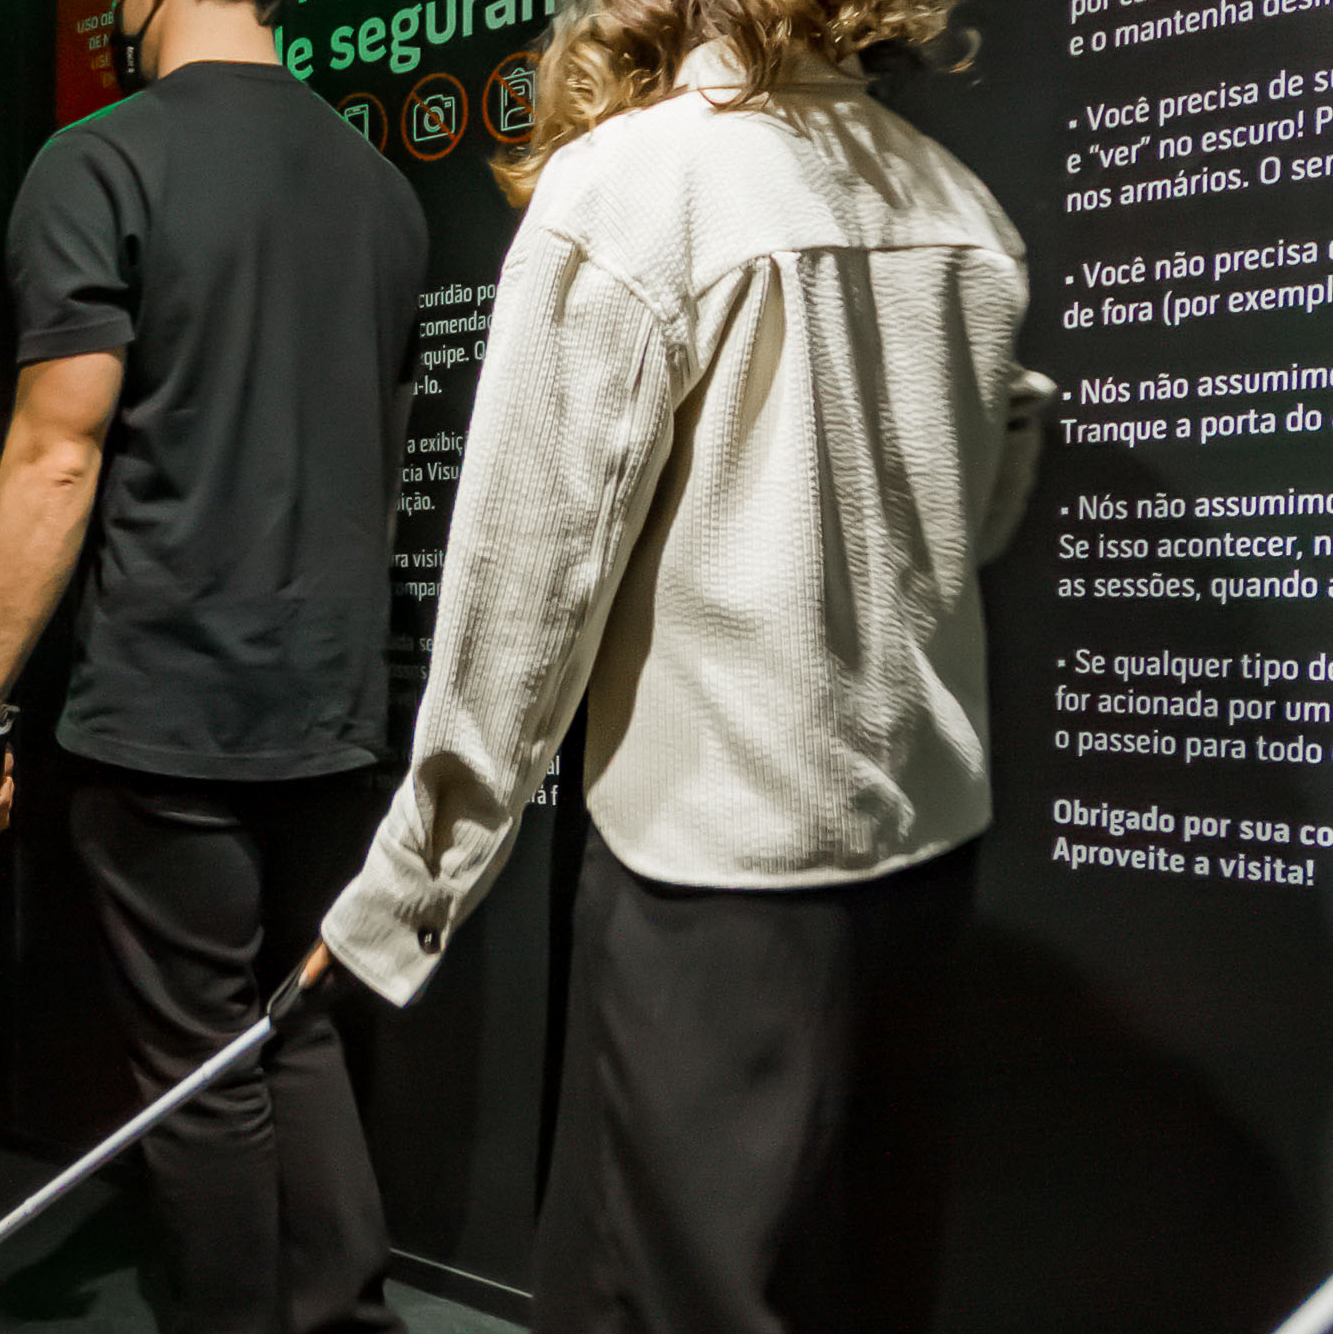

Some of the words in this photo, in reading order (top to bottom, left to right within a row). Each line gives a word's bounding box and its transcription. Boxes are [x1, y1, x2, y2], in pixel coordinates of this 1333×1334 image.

[1069, 36, 1084, 56] e
[1091, 31, 1106, 51] o
[1086, 97, 1150, 131] Você
[1158, 82, 1259, 127] precisa
[1268, 70, 1304, 99] de
[1314, 69, 1333, 92] s
[1067, 153, 1081, 174] e
[1158, 135, 1192, 159] no
[1201, 110, 1304, 152] escuro!
[1066, 187, 1112, 213] nos
[1120, 167, 1249, 205] armários.
[1259, 156, 1281, 184] O
[1082, 256, 1146, 289] Você
[1155, 251, 1205, 281] não
[1214, 239, 1318, 282] precisa
[1063, 301, 1094, 329] de
[1101, 297, 1153, 326] fora
[1163, 290, 1220, 326] (por
[1228, 274, 1333, 314] exempl
[421, 344, 469, 370] quipe.
[1081, 376, 1130, 405] Nós
[1139, 373, 1188, 401] não
[1197, 363, 1333, 397] assumim
[1060, 418, 1167, 448] Tranque
[1175, 417, 1191, 438] a
[1200, 409, 1276, 445] porta
[1285, 403, 1322, 432] do
[1078, 493, 1128, 520] Nós
[1137, 492, 1186, 518] não
[1058, 534, 1089, 559] Se
[1098, 533, 1149, 558] isso
[1157, 533, 1303, 560] acontecer,
[1314, 534, 1333, 557] n
[1058, 578, 1086, 597] as
[1094, 573, 1202, 602] sessões,
[1210, 569, 1318, 605] quando
[1074, 649, 1106, 674] Se
[1113, 649, 1233, 684] qualquer
[1241, 653, 1299, 687] tipo
[1054, 685, 1091, 711] for
[1097, 689, 1218, 718] acionada
[1228, 698, 1276, 726] por
[1285, 701, 1331, 722] um
[1054, 730, 1069, 749] o
[1077, 729, 1176, 757] passeio
[1185, 736, 1246, 764] para
[1257, 735, 1323, 764] todo
[1052, 799, 1175, 836] Obrigado
[1182, 814, 1231, 842] por
[1239, 818, 1290, 844] sua
[1052, 835, 1186, 873] Aproveite
[1194, 855, 1210, 876] a
[1219, 853, 1315, 886] visita!
